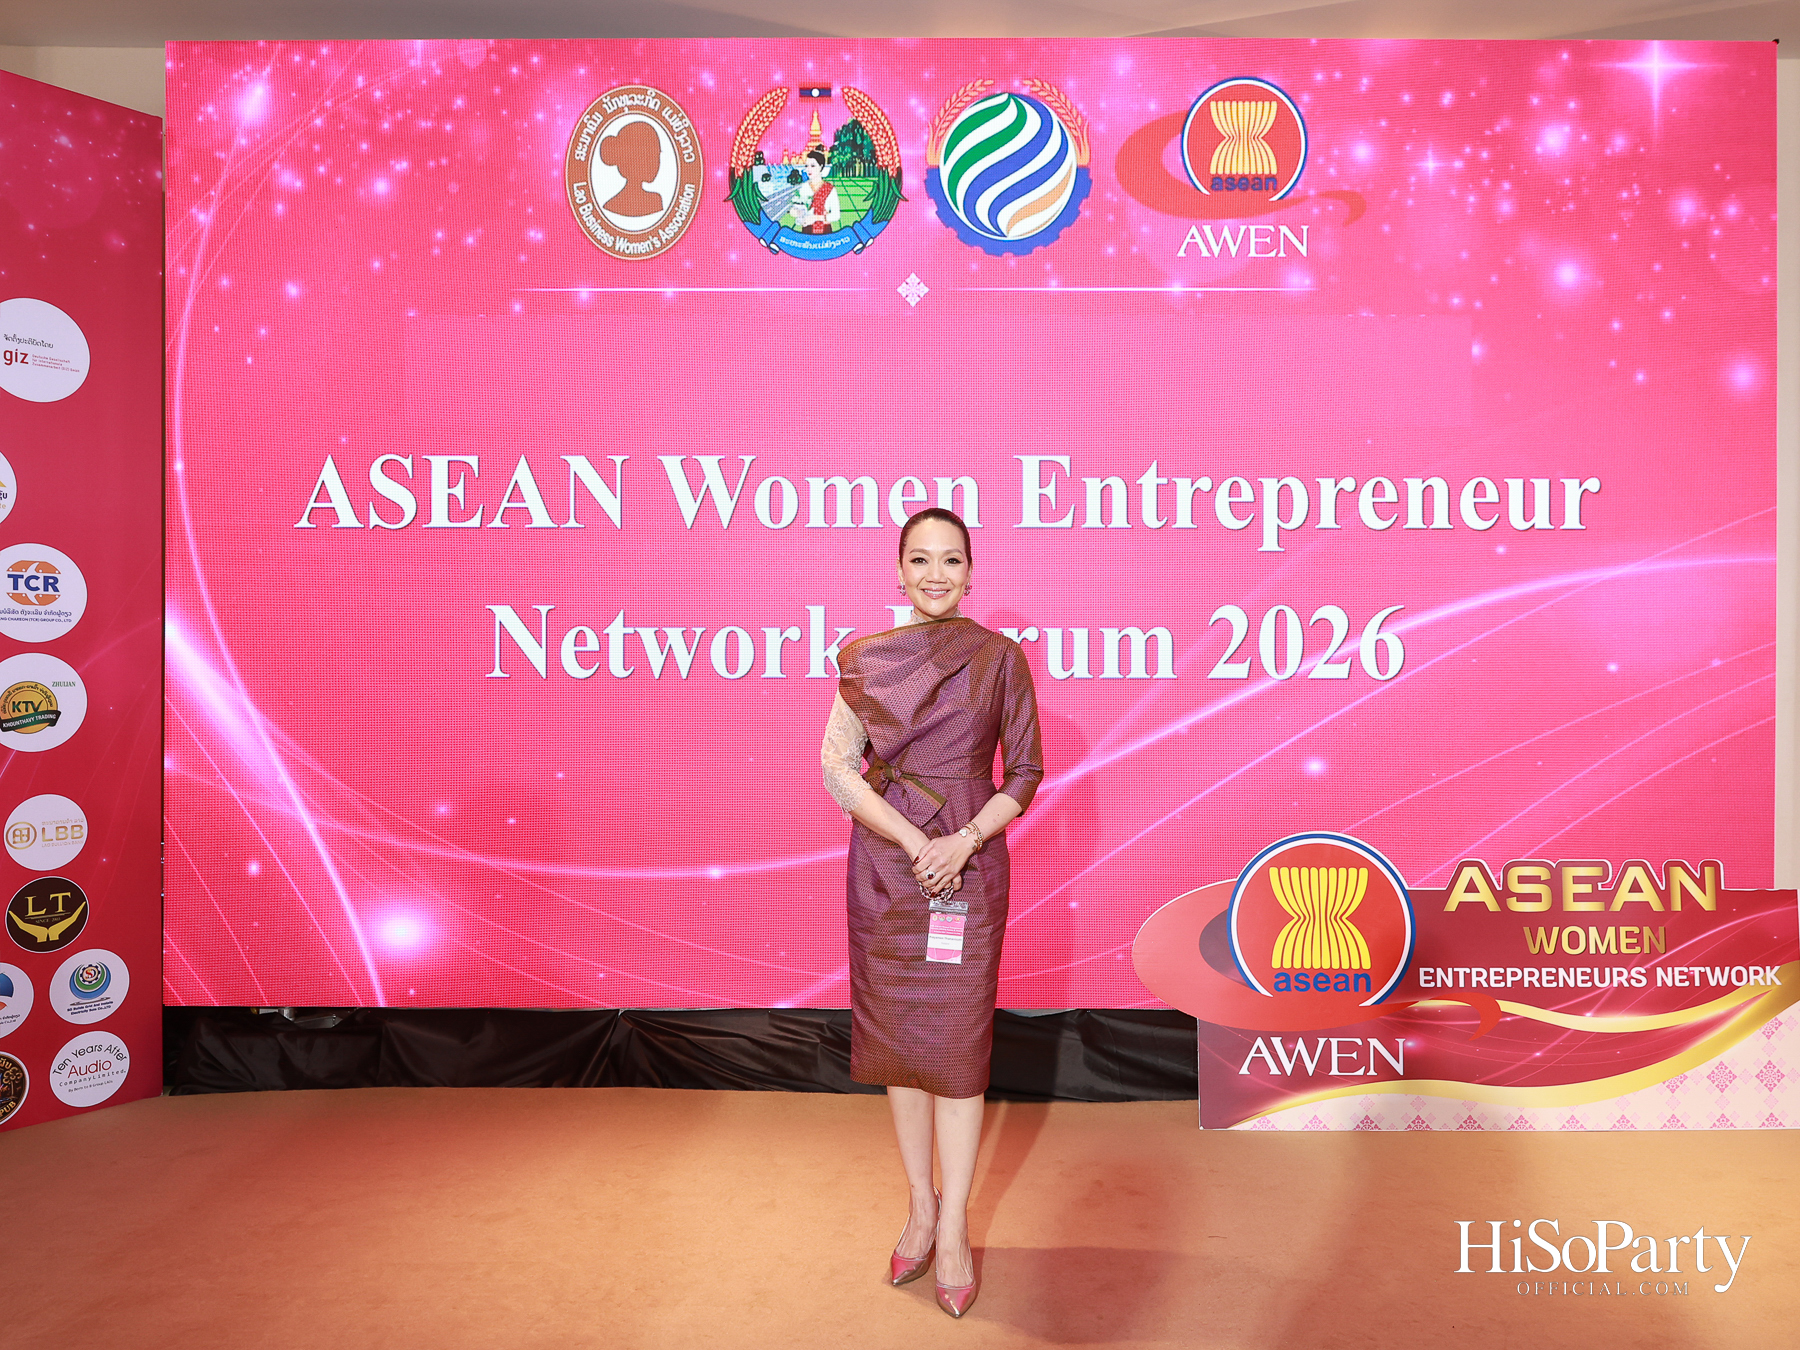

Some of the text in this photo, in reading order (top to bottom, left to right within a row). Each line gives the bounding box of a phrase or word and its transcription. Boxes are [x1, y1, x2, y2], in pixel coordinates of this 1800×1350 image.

[1211, 176, 1278, 192] asean
[573, 182, 696, 254] Lao Business Women's Association
[1177, 225, 1309, 258] AWEN
[4, 349, 28, 366] giz
[294, 454, 1601, 552] ASEAN Women Entrepreneur
[7, 574, 60, 592] TCR
[485, 604, 856, 679] Network
[1206, 604, 1405, 681] 2026
[12, 699, 44, 713] KTV
[42, 825, 84, 842] LBB
[1443, 866, 1717, 912] ASEAN
[25, 892, 71, 916] L T
[1523, 926, 1667, 955] WOMEN
[1272, 970, 1371, 993] asean
[1419, 966, 1782, 988] ENTREPRENEURS NETWORK
[52, 1044, 127, 1074] Ten Years After
[1238, 1037, 1406, 1076] AWEN
[68, 1060, 112, 1078] Audio
